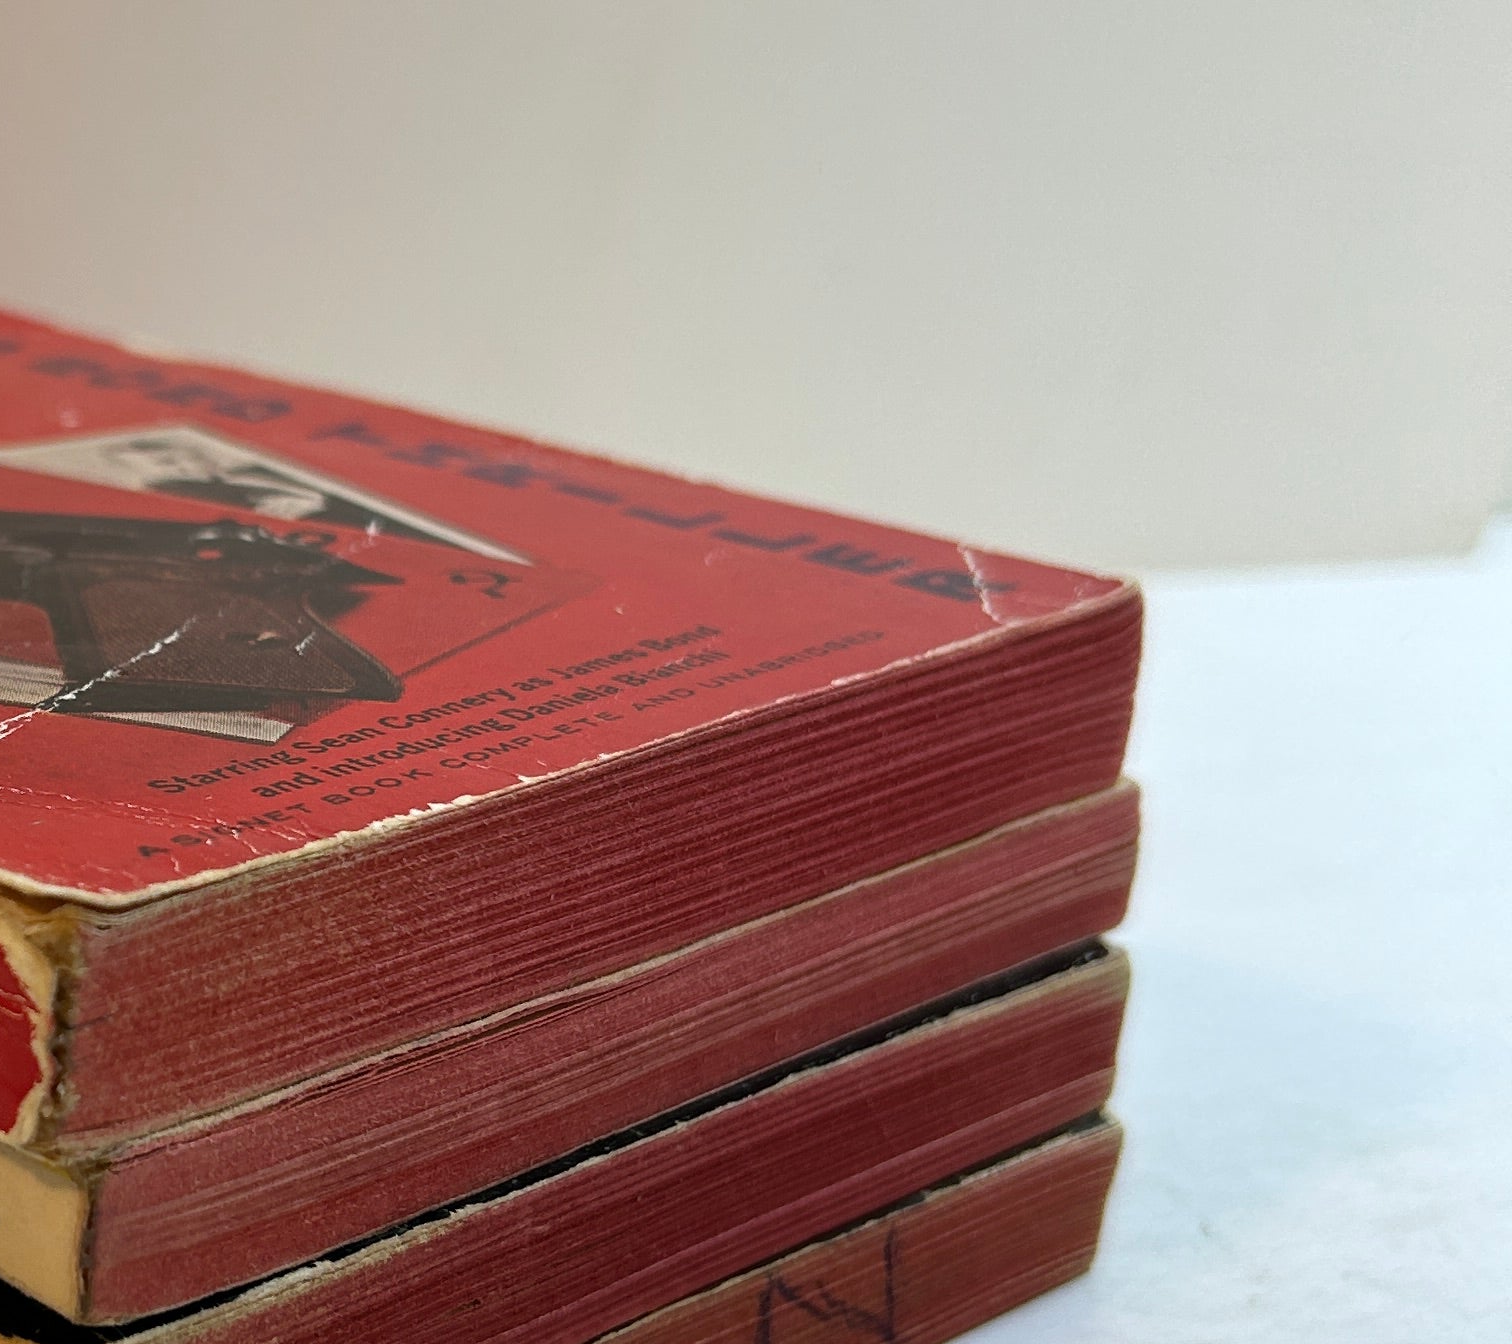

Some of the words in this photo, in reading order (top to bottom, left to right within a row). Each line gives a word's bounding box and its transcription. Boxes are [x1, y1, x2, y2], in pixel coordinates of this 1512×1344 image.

[146, 749, 307, 794] Starring
[292, 723, 386, 755] Sean
[377, 687, 518, 730] Connery
[512, 674, 554, 694] as
[548, 647, 649, 681] James
[638, 623, 722, 653] Bond
[251, 773, 325, 799] and
[311, 716, 518, 779] introducing
[508, 681, 624, 724] Daniela
[611, 648, 733, 689] Bianchi
[320, 766, 434, 806] BOOK
[438, 710, 624, 770] COMPLETE
[631, 687, 697, 713] AND
